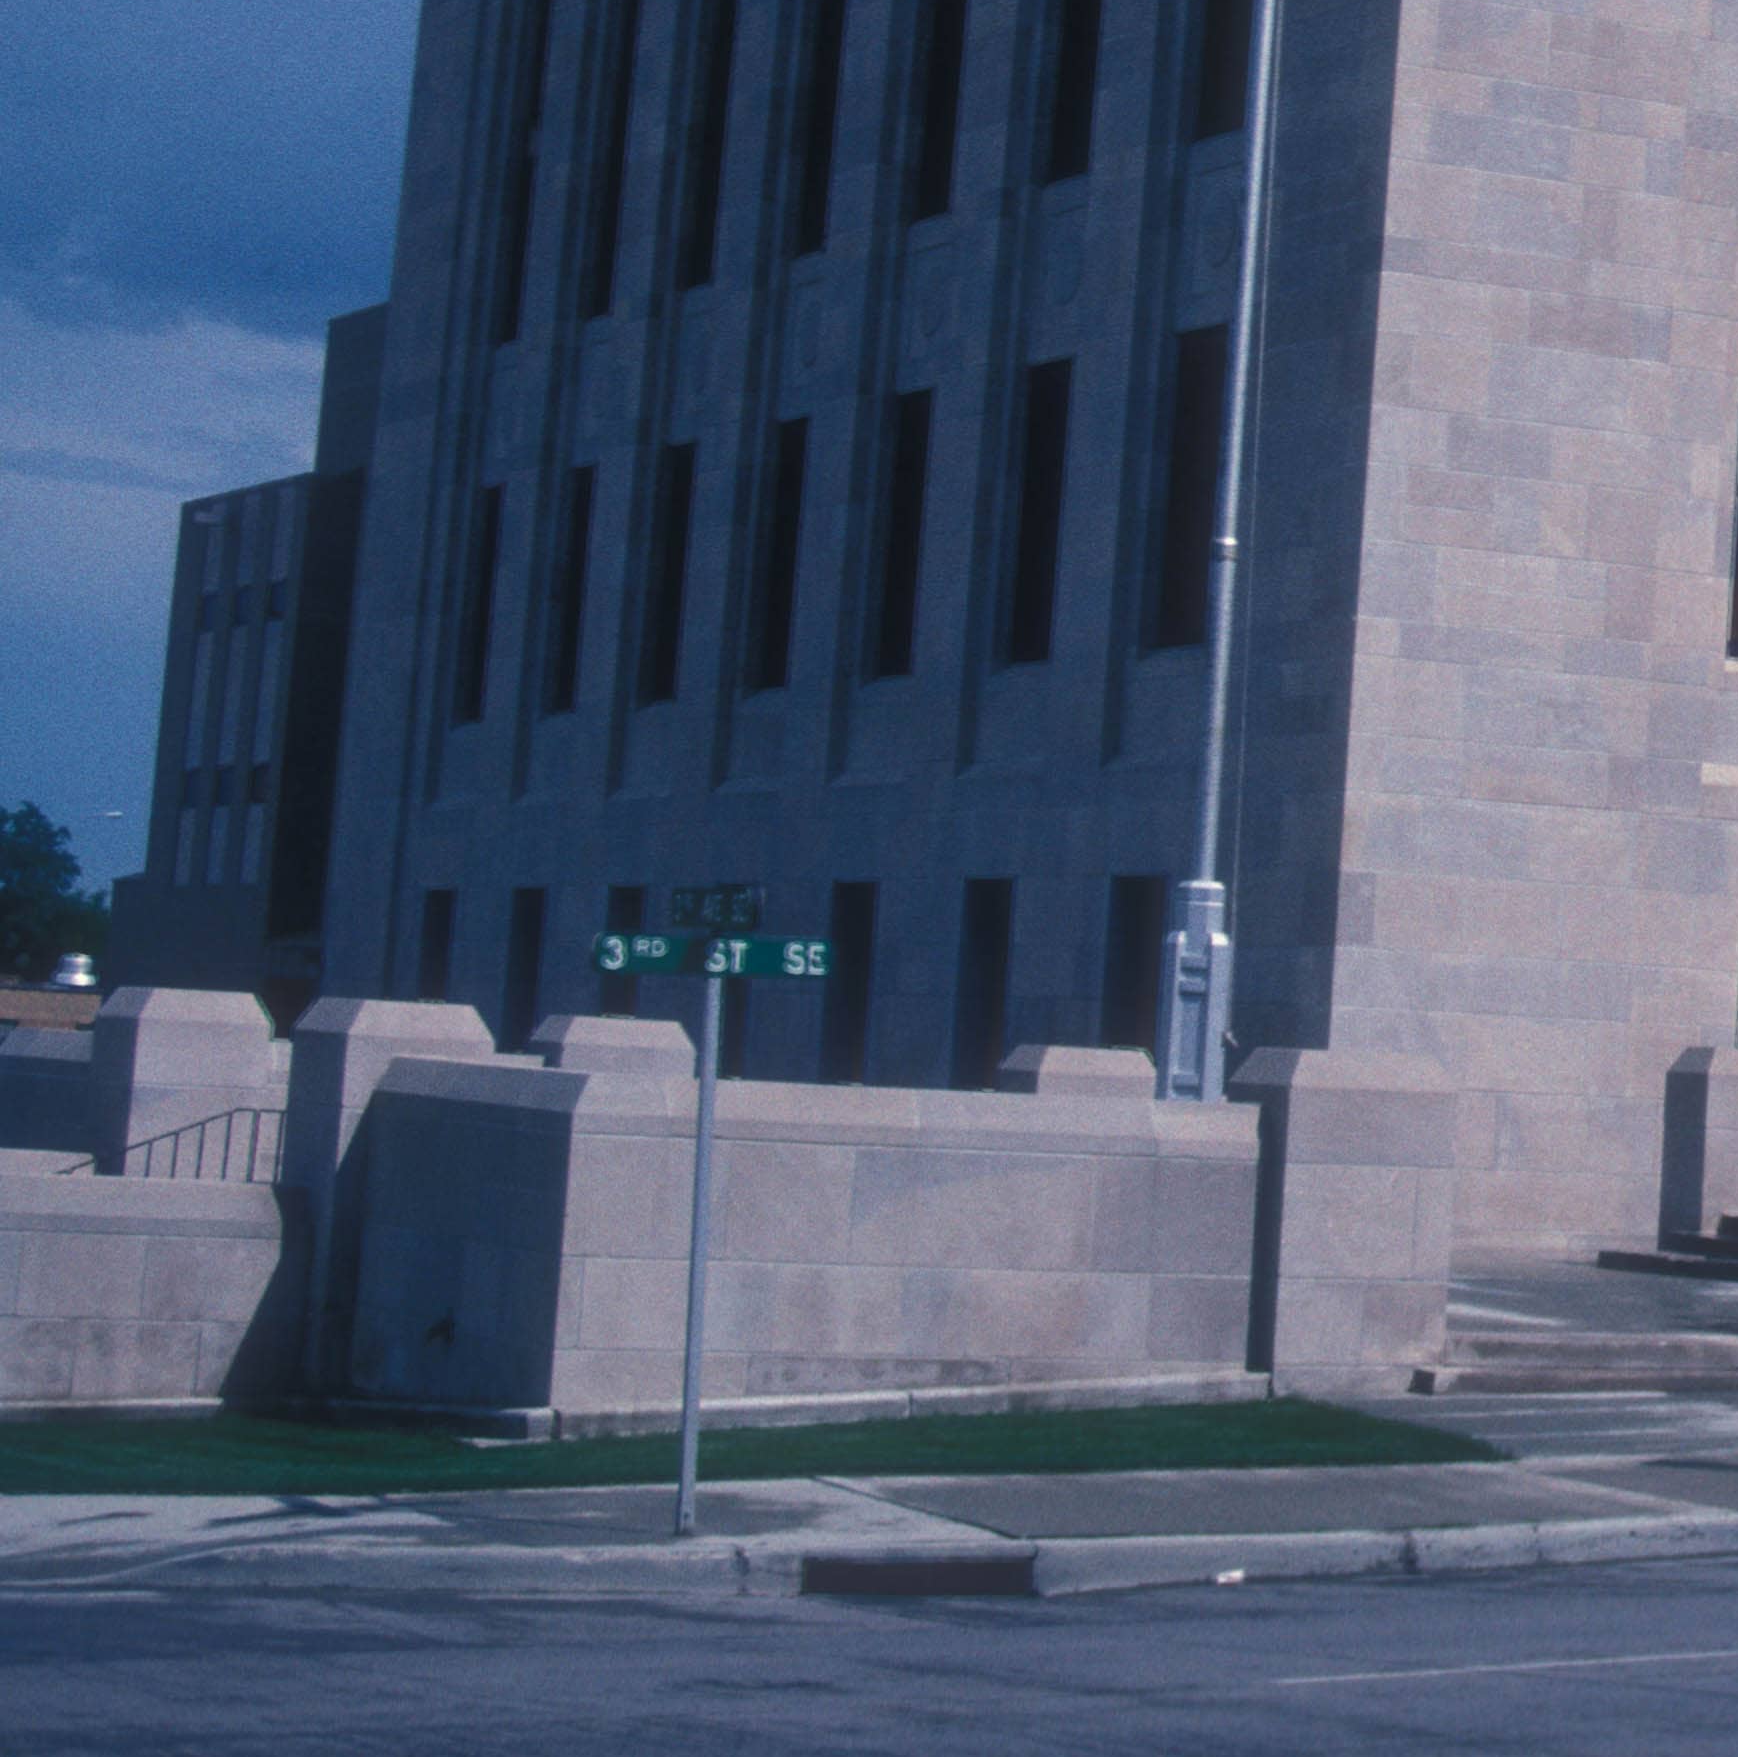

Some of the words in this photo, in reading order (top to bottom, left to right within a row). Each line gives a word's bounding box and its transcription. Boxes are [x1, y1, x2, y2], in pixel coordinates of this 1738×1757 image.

[600, 935, 669, 971] 3RD
[705, 938, 749, 973] ST
[783, 940, 828, 976] SE
